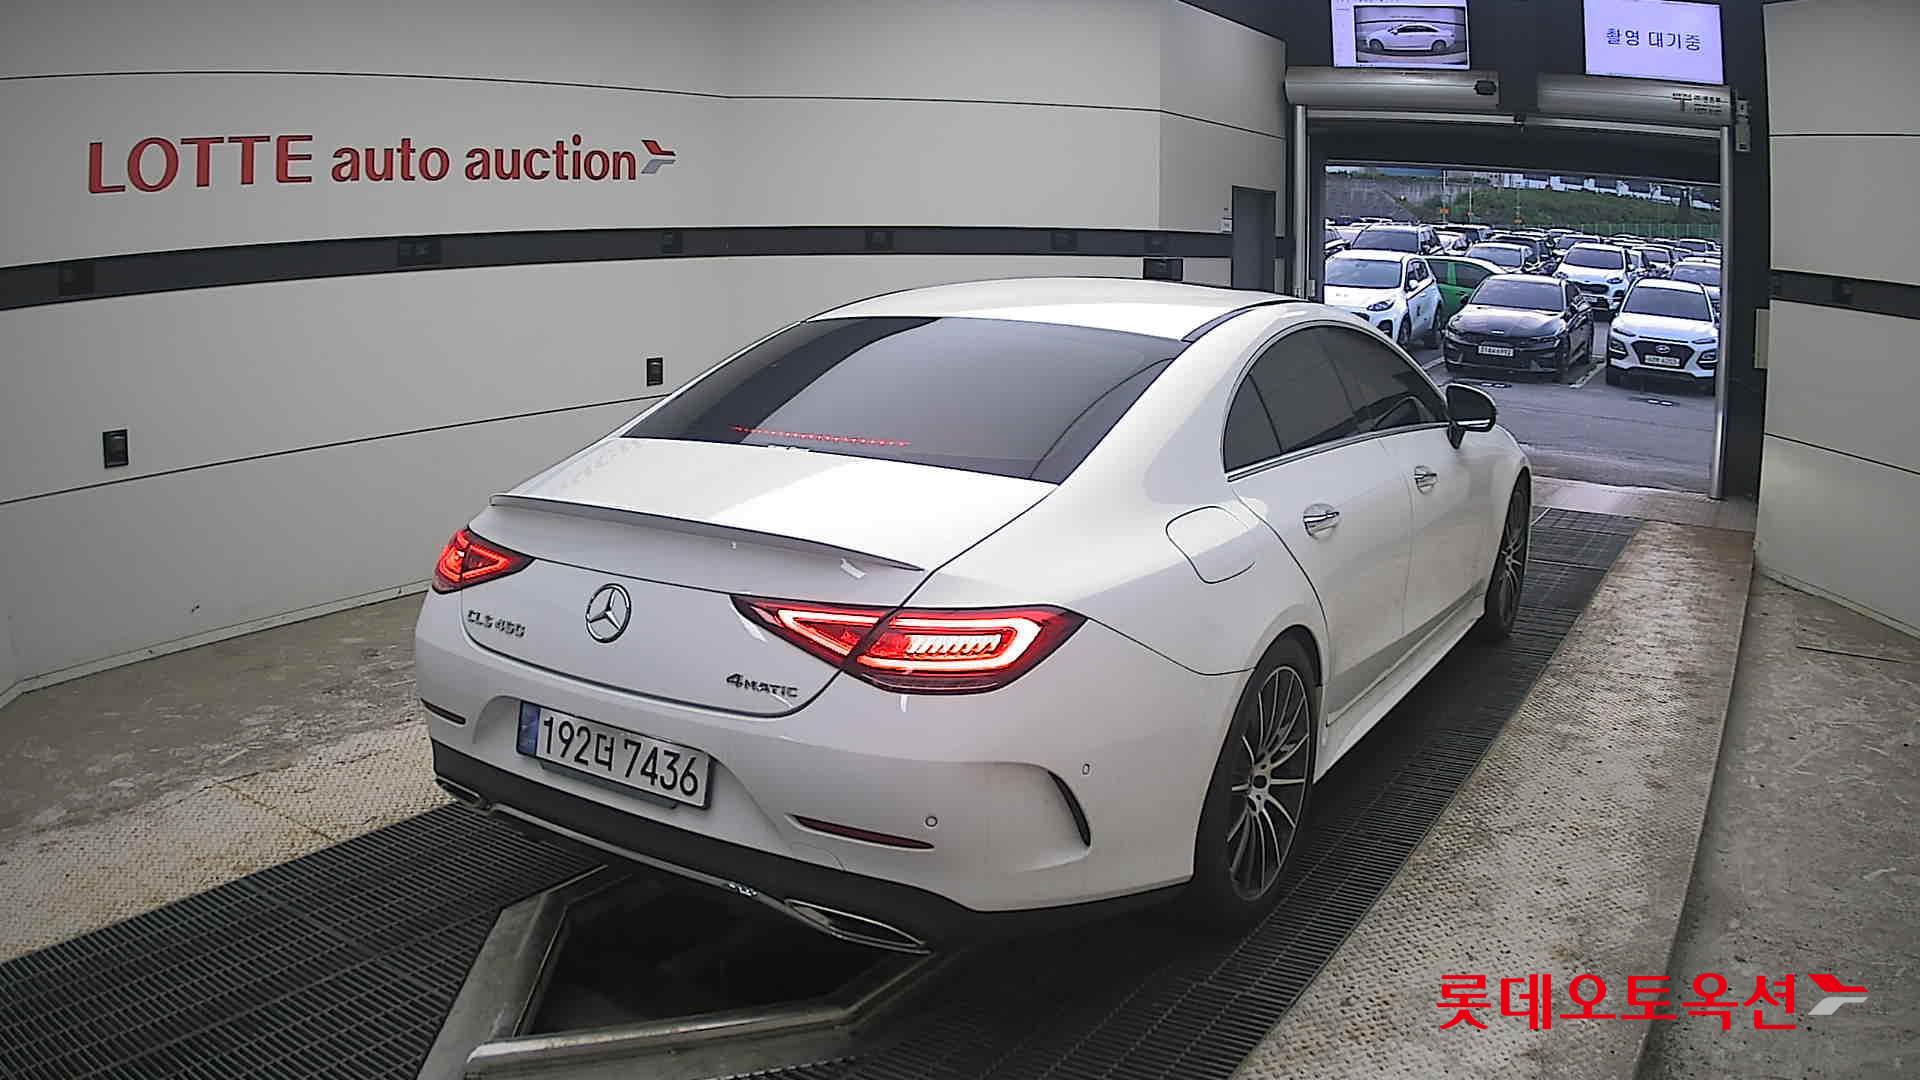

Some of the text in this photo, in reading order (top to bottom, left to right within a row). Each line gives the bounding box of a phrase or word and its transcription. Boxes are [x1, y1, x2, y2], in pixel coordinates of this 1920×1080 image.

[1606, 28, 1701, 51] 촬영 대기중
[88, 134, 637, 193] LOTTE auto auction
[467, 609, 493, 628] CLS
[726, 673, 798, 697] 4MATIC
[543, 716, 699, 797] 192더 7436
